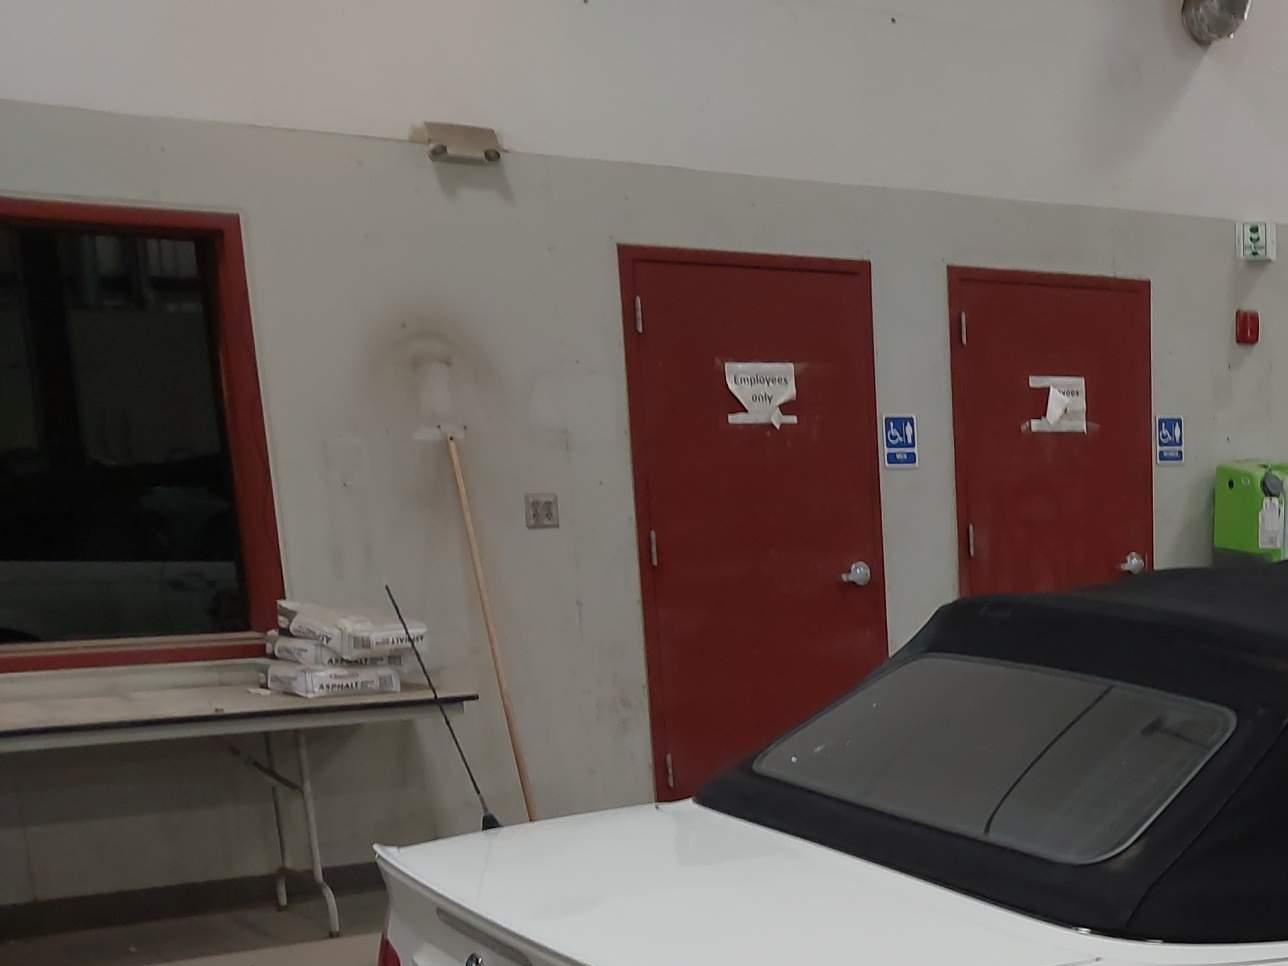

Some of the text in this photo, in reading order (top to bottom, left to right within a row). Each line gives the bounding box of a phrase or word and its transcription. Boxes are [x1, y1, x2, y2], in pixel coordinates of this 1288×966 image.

[733, 373, 789, 388] Employees
[752, 392, 774, 405] only
[319, 680, 359, 691] ASPHALT
